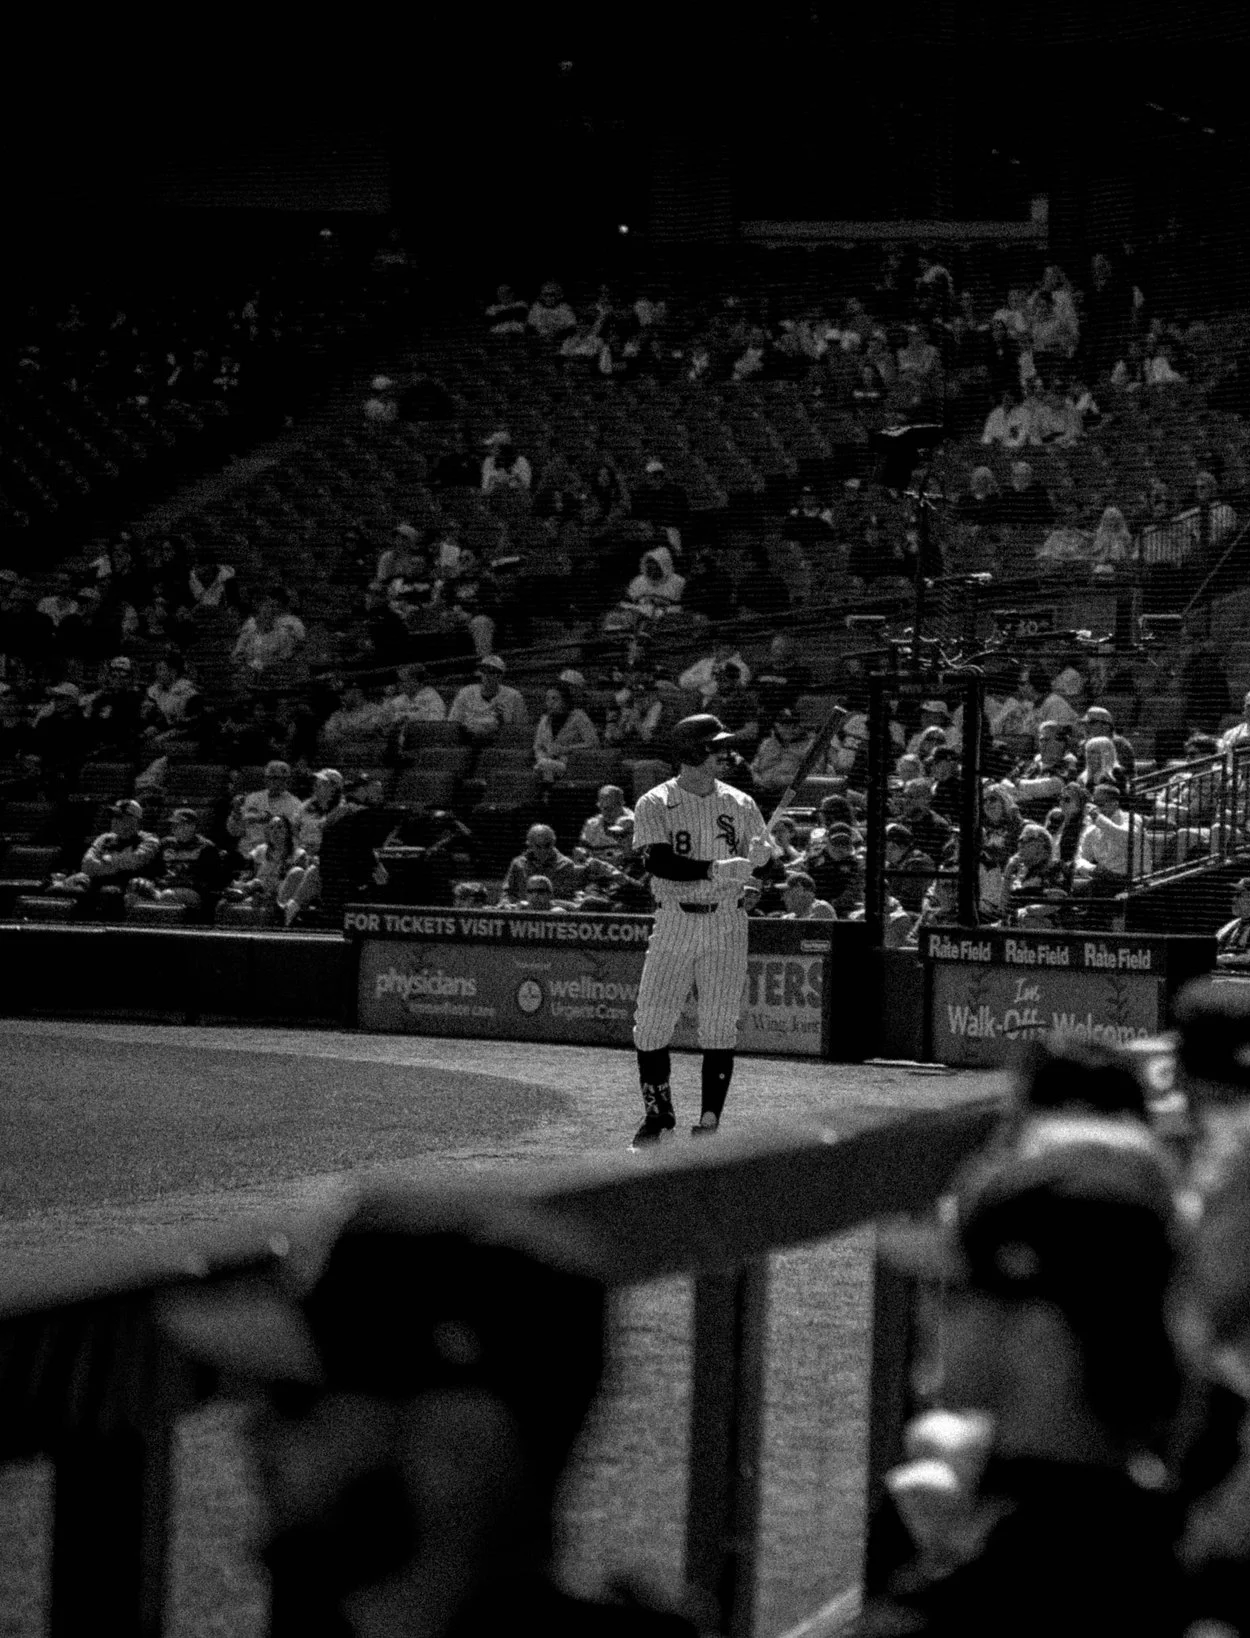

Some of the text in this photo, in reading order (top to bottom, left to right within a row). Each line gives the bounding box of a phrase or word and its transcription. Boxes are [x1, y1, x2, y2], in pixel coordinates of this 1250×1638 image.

[343, 912, 650, 943] FOR TICKETS VISIT WHITESOX.COM
[928, 934, 992, 962] Rate Field
[1004, 938, 1070, 966] Rate Field
[1083, 942, 1151, 970] Rate Field
[374, 966, 478, 1001] physicians
[549, 975, 640, 1001] wellnow
